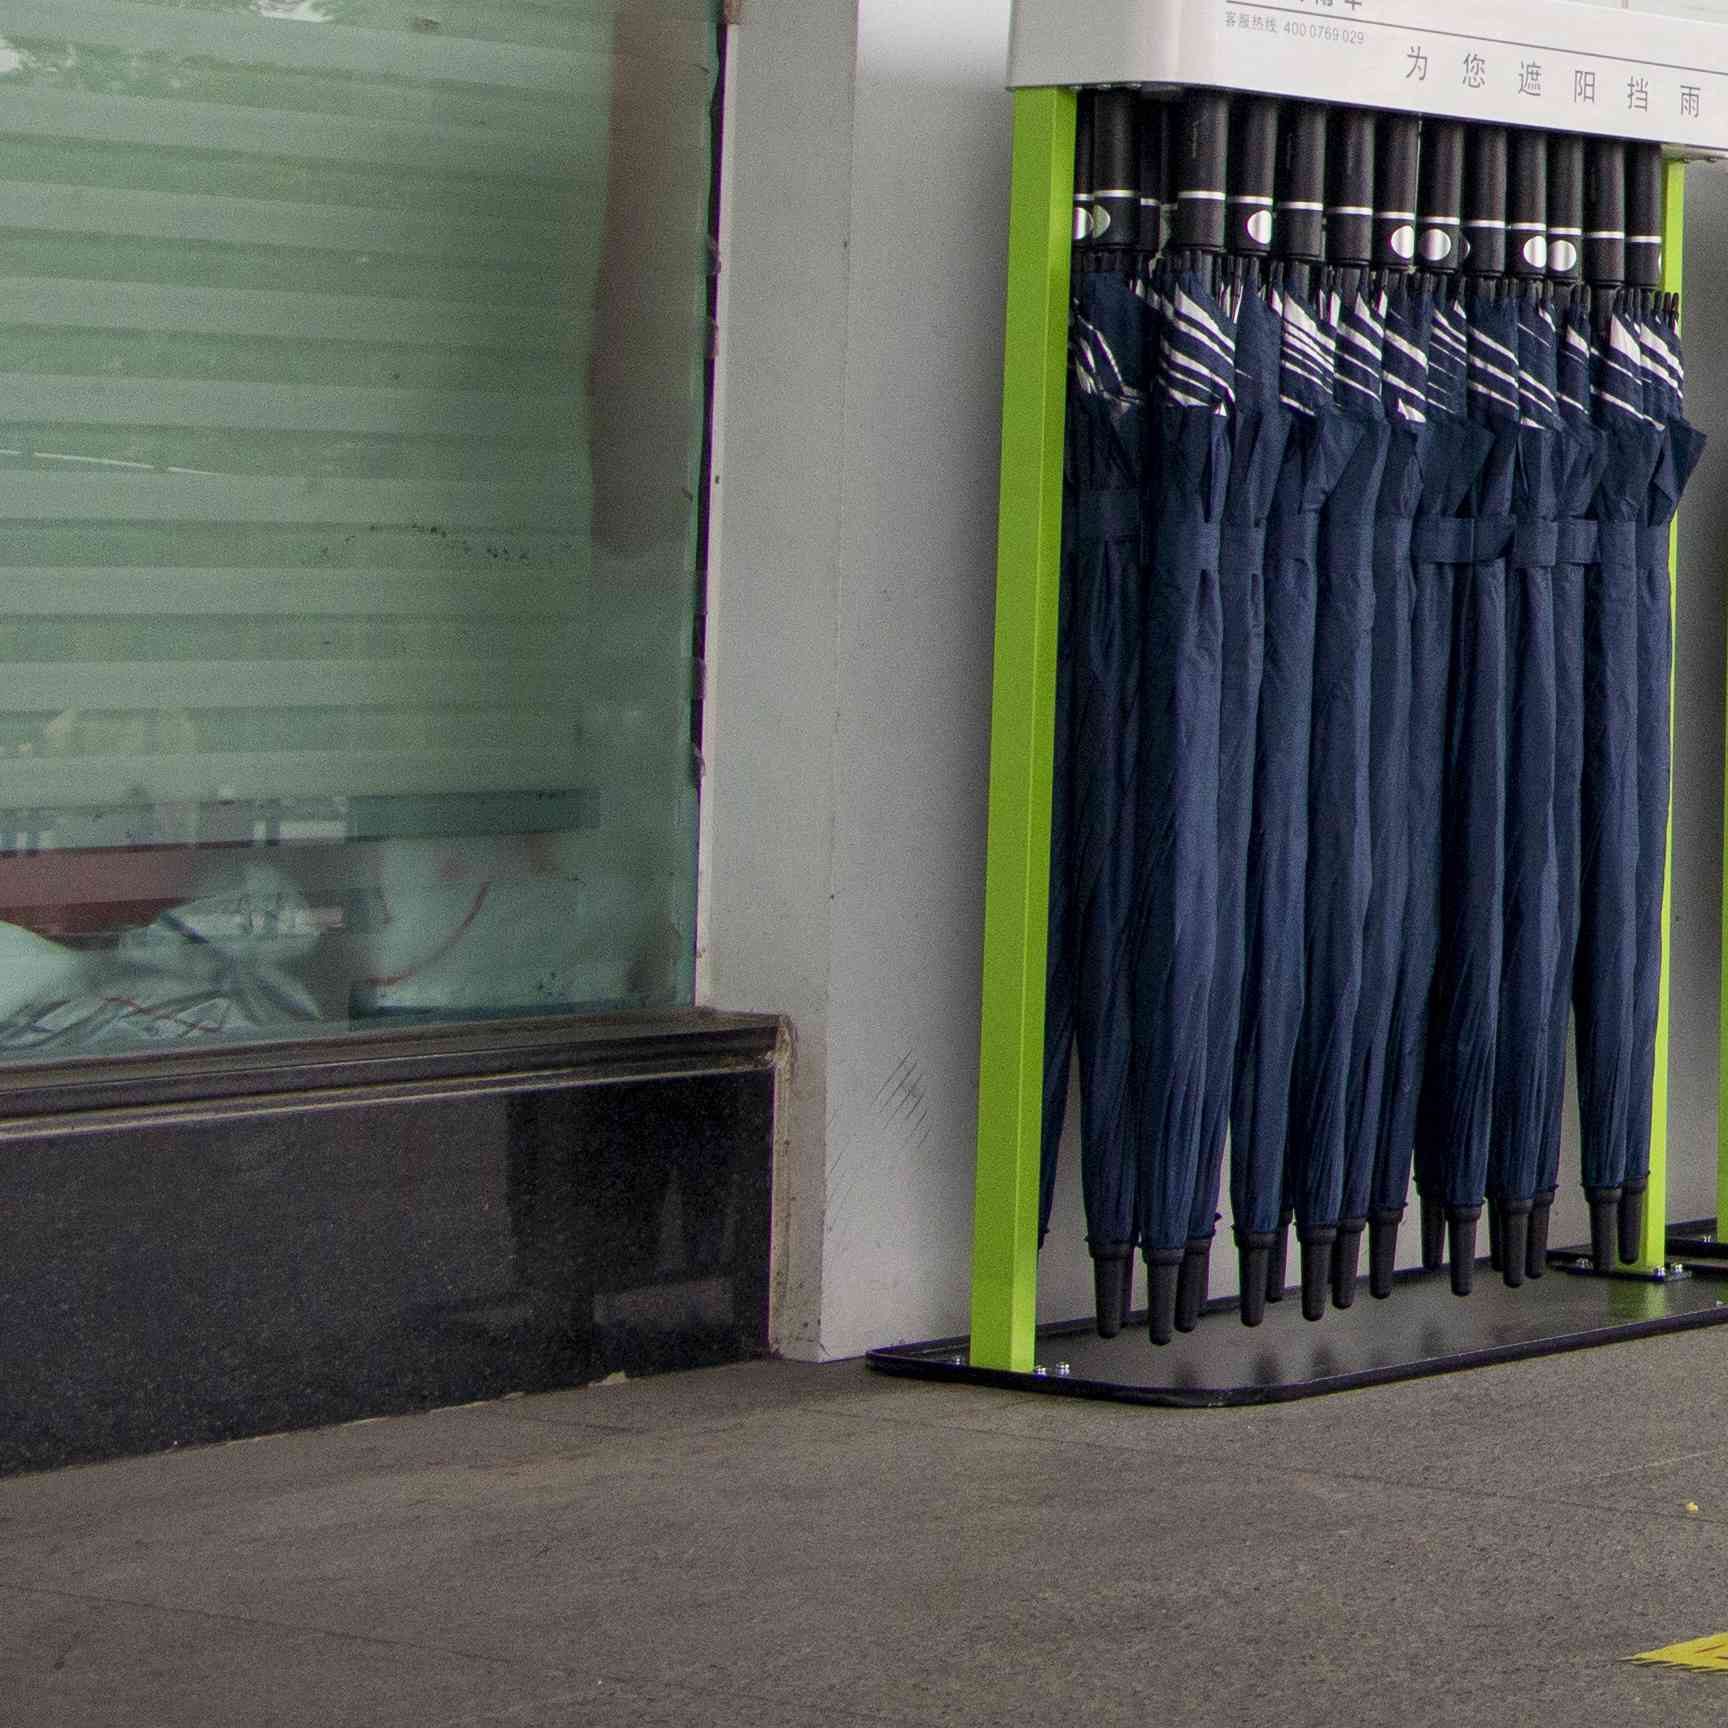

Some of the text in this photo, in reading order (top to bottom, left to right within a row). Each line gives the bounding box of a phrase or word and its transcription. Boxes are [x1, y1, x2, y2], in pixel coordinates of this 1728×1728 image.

[1406, 45, 1701, 119] 为您遮阳挡雨
